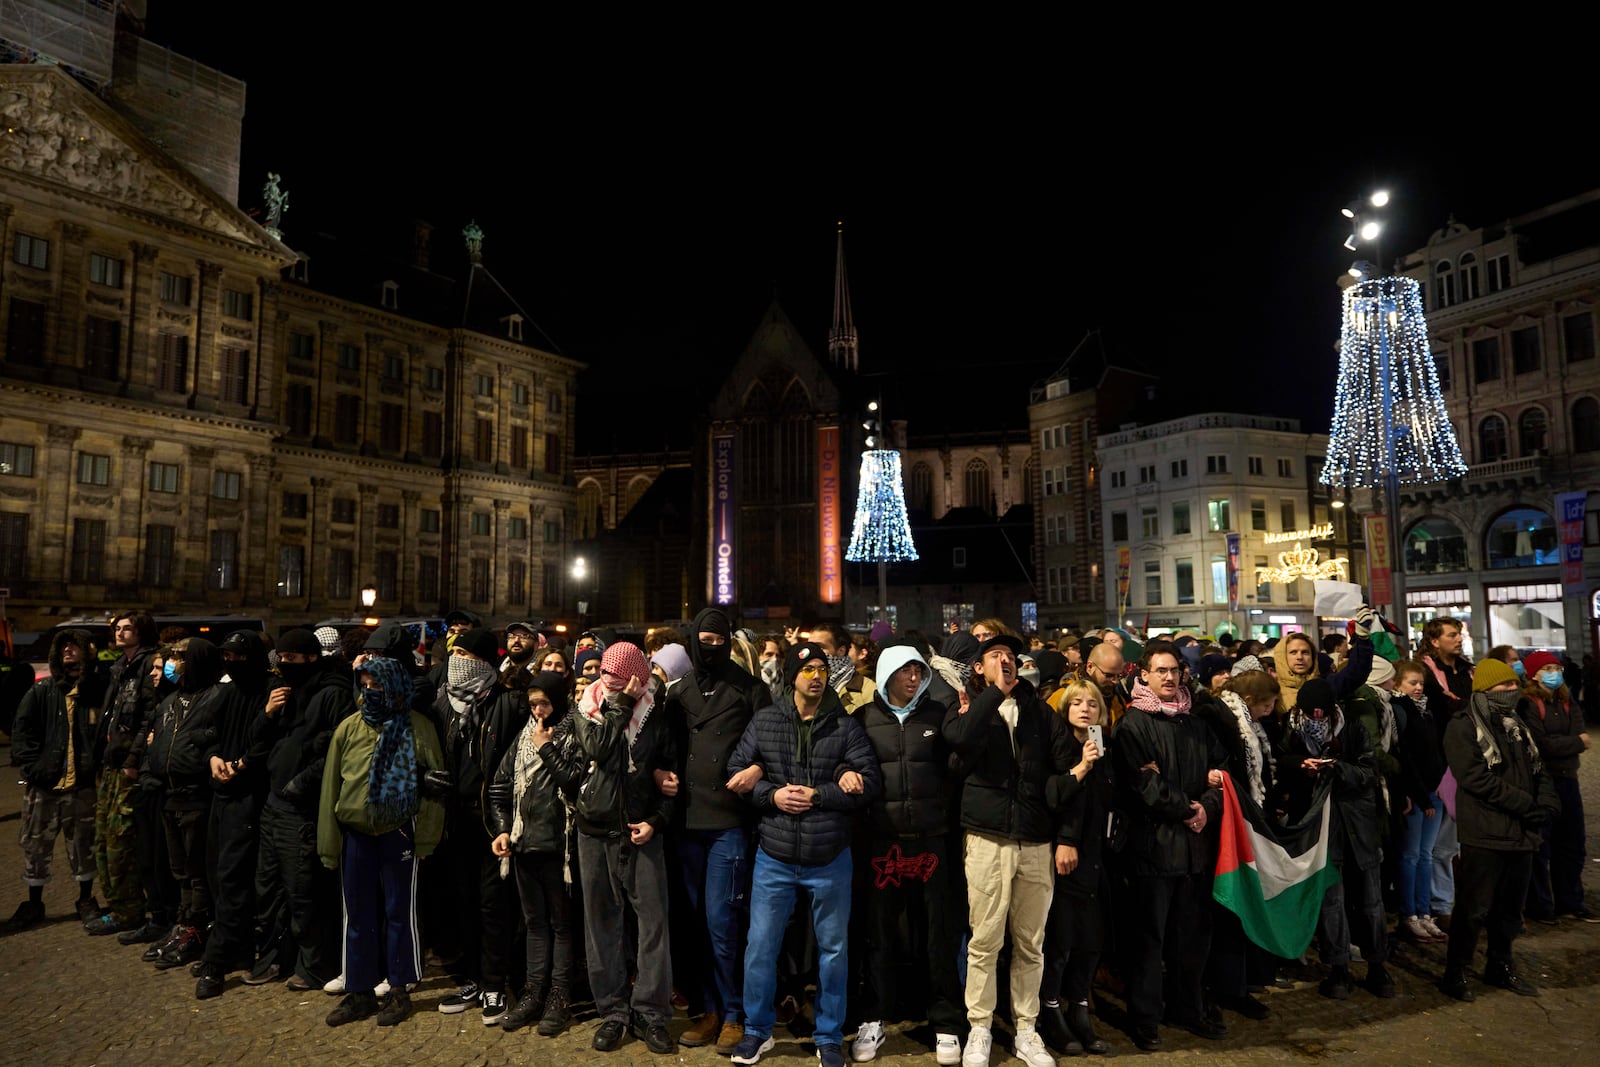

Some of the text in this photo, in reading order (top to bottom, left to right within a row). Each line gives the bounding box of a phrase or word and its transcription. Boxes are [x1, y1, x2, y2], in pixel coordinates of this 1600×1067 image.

[716, 440, 732, 604] Explore Ontdek
[822, 450, 837, 581] De Nieuwe Kerk
